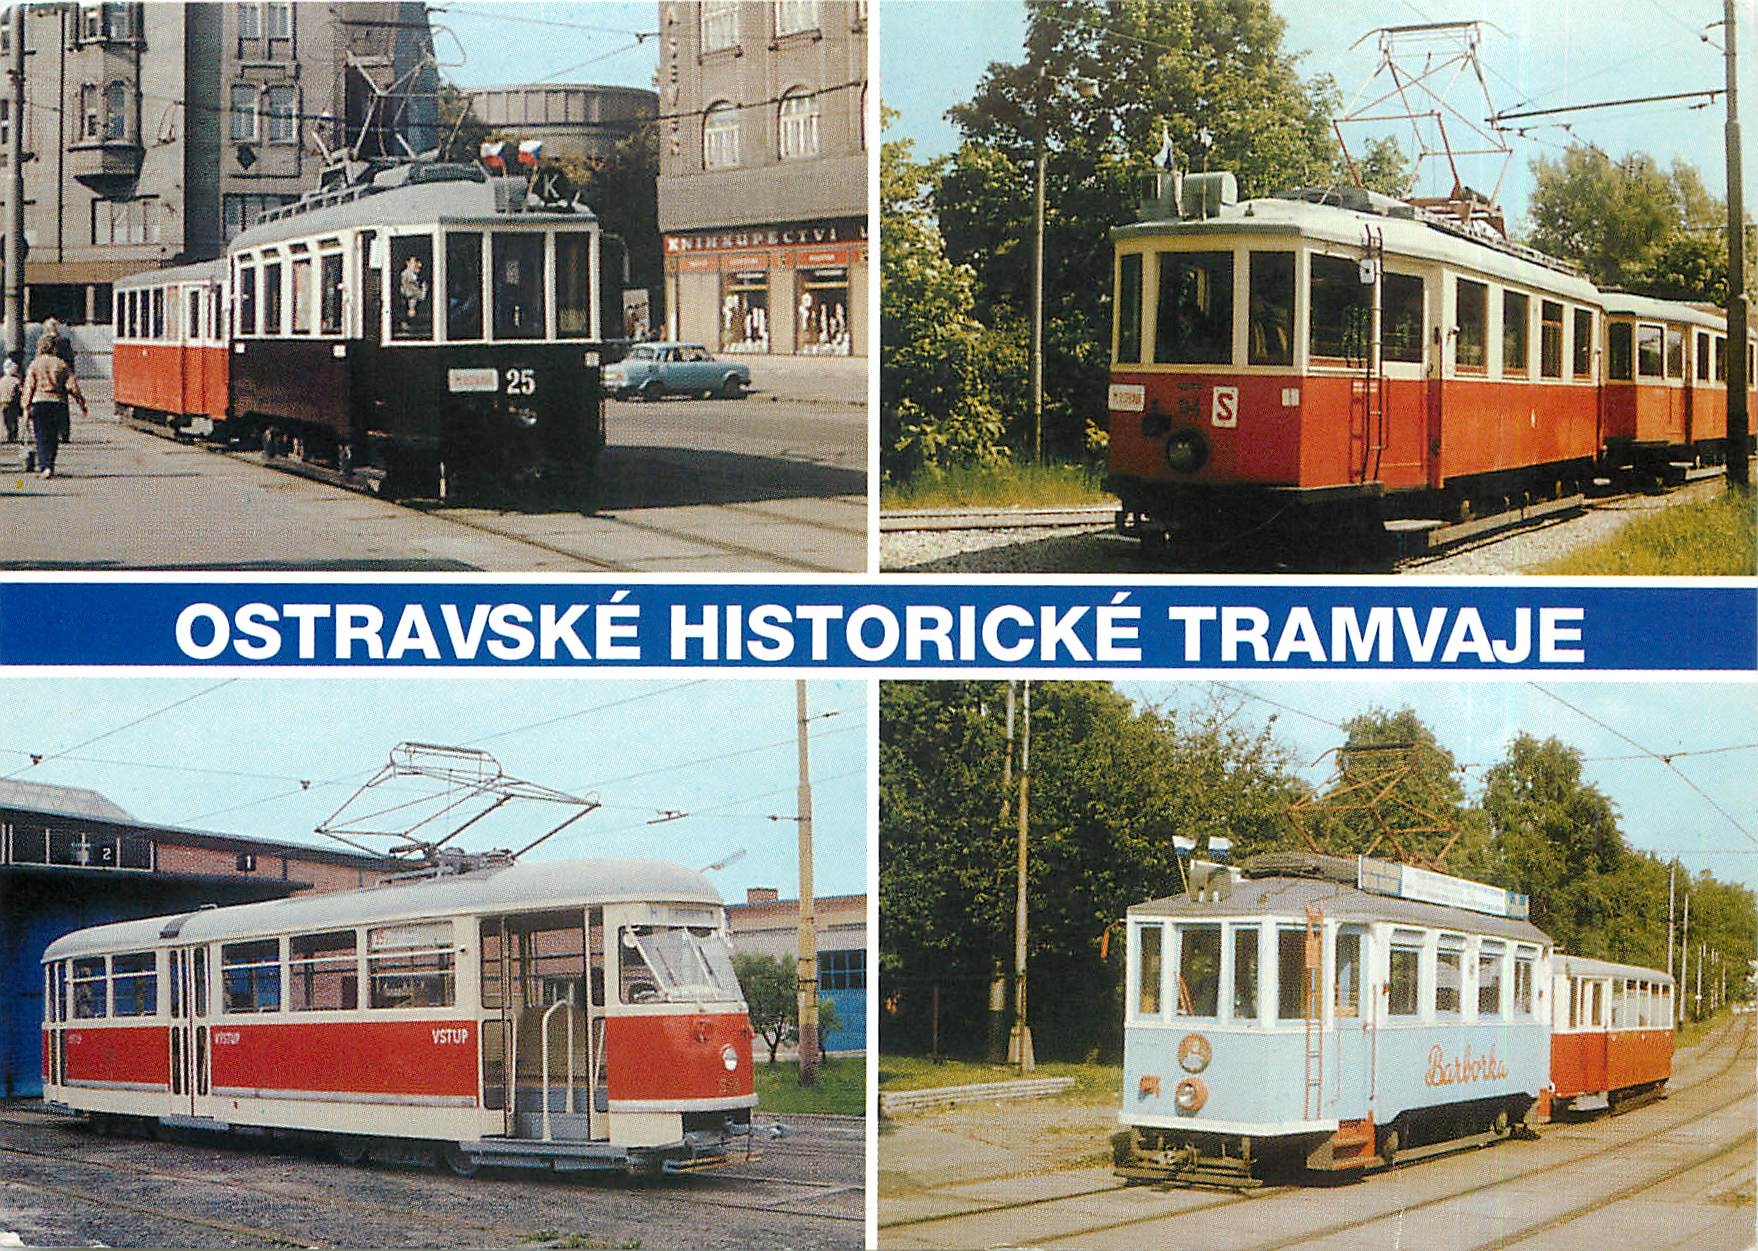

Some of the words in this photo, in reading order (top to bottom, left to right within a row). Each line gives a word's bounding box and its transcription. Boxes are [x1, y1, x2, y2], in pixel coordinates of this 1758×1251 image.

[544, 173, 560, 198] K
[506, 368, 536, 395] 25
[1217, 392, 1233, 421] S
[102, 847, 112, 861] 2
[432, 1028, 469, 1045] VSTUP
[1424, 1042, 1509, 1087] Barborka
